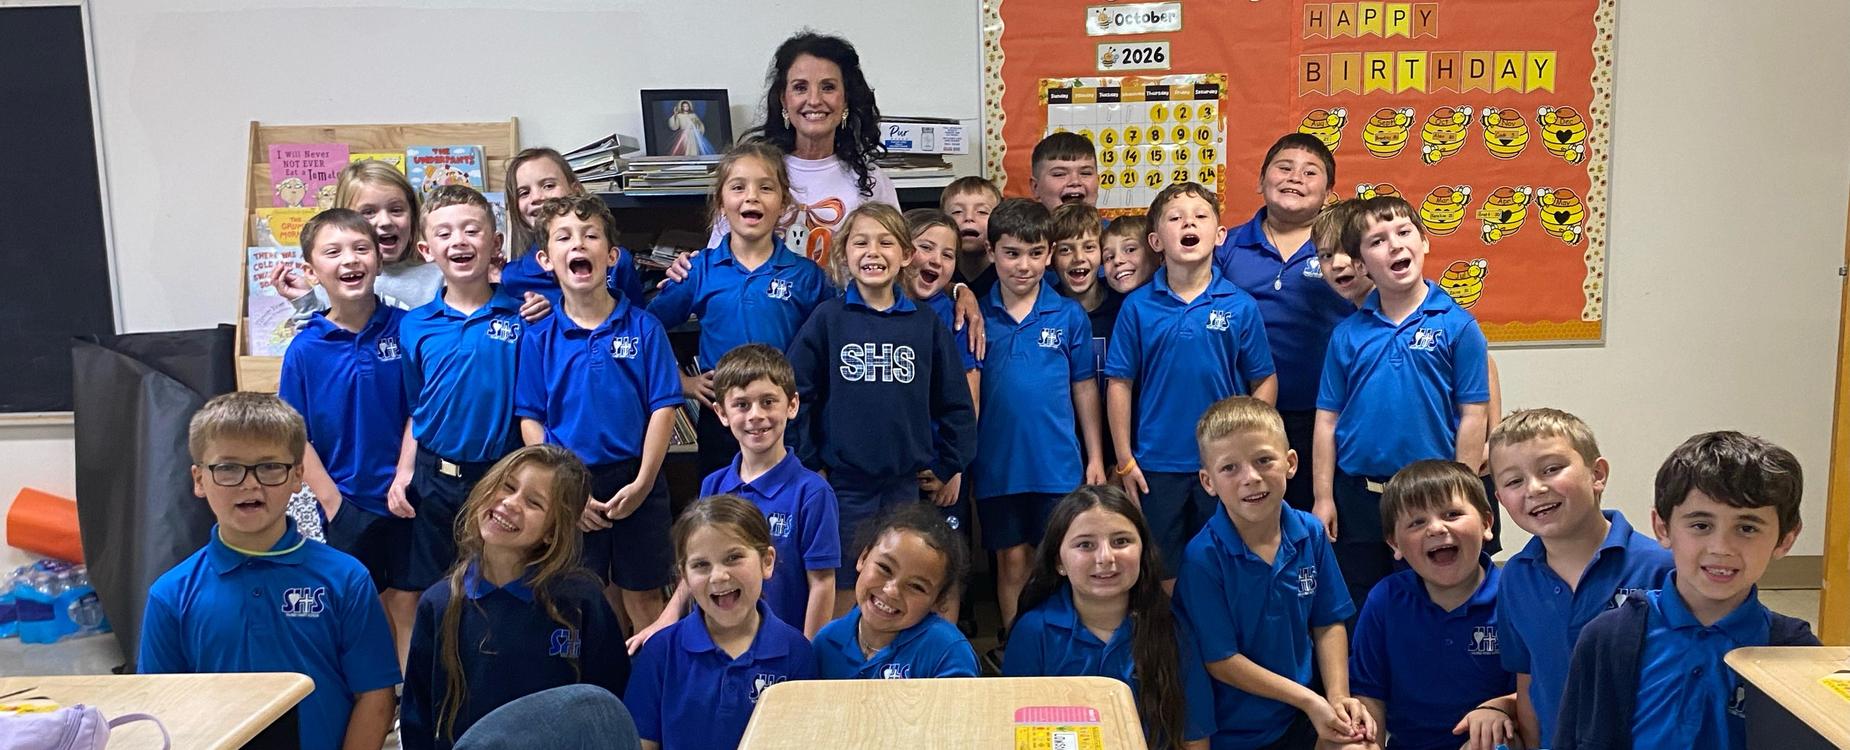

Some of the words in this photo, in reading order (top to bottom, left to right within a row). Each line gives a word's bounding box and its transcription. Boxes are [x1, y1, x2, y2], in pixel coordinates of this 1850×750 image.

[1115, 11, 1175, 26] October
[1310, 9, 1432, 27] HAPPY
[1122, 46, 1164, 64] 2026
[1306, 59, 1548, 82] BIRTHDAY
[1157, 108, 1161, 119] 1
[1180, 107, 1187, 119] 2
[1203, 107, 1211, 119] 3
[889, 125, 909, 137] Pur
[1105, 132, 1113, 143] 6
[1130, 130, 1137, 142] 7
[1151, 129, 1159, 141] 8
[1177, 128, 1185, 140] 9
[1198, 129, 1209, 141] 10
[277, 150, 281, 159] I
[304, 150, 330, 158] Never
[1103, 150, 1114, 163] 13
[1125, 149, 1137, 163] 14
[1151, 150, 1162, 161] 15
[1175, 149, 1187, 160] 16
[1202, 149, 1214, 160] 17
[283, 160, 300, 168] NOT
[303, 159, 326, 168] EVER
[1101, 173, 1115, 185] 20
[1124, 172, 1135, 183] 21
[1147, 172, 1162, 186] 22
[1173, 170, 1188, 181] 23
[1199, 168, 1216, 183] 24
[840, 343, 915, 383] SHS
